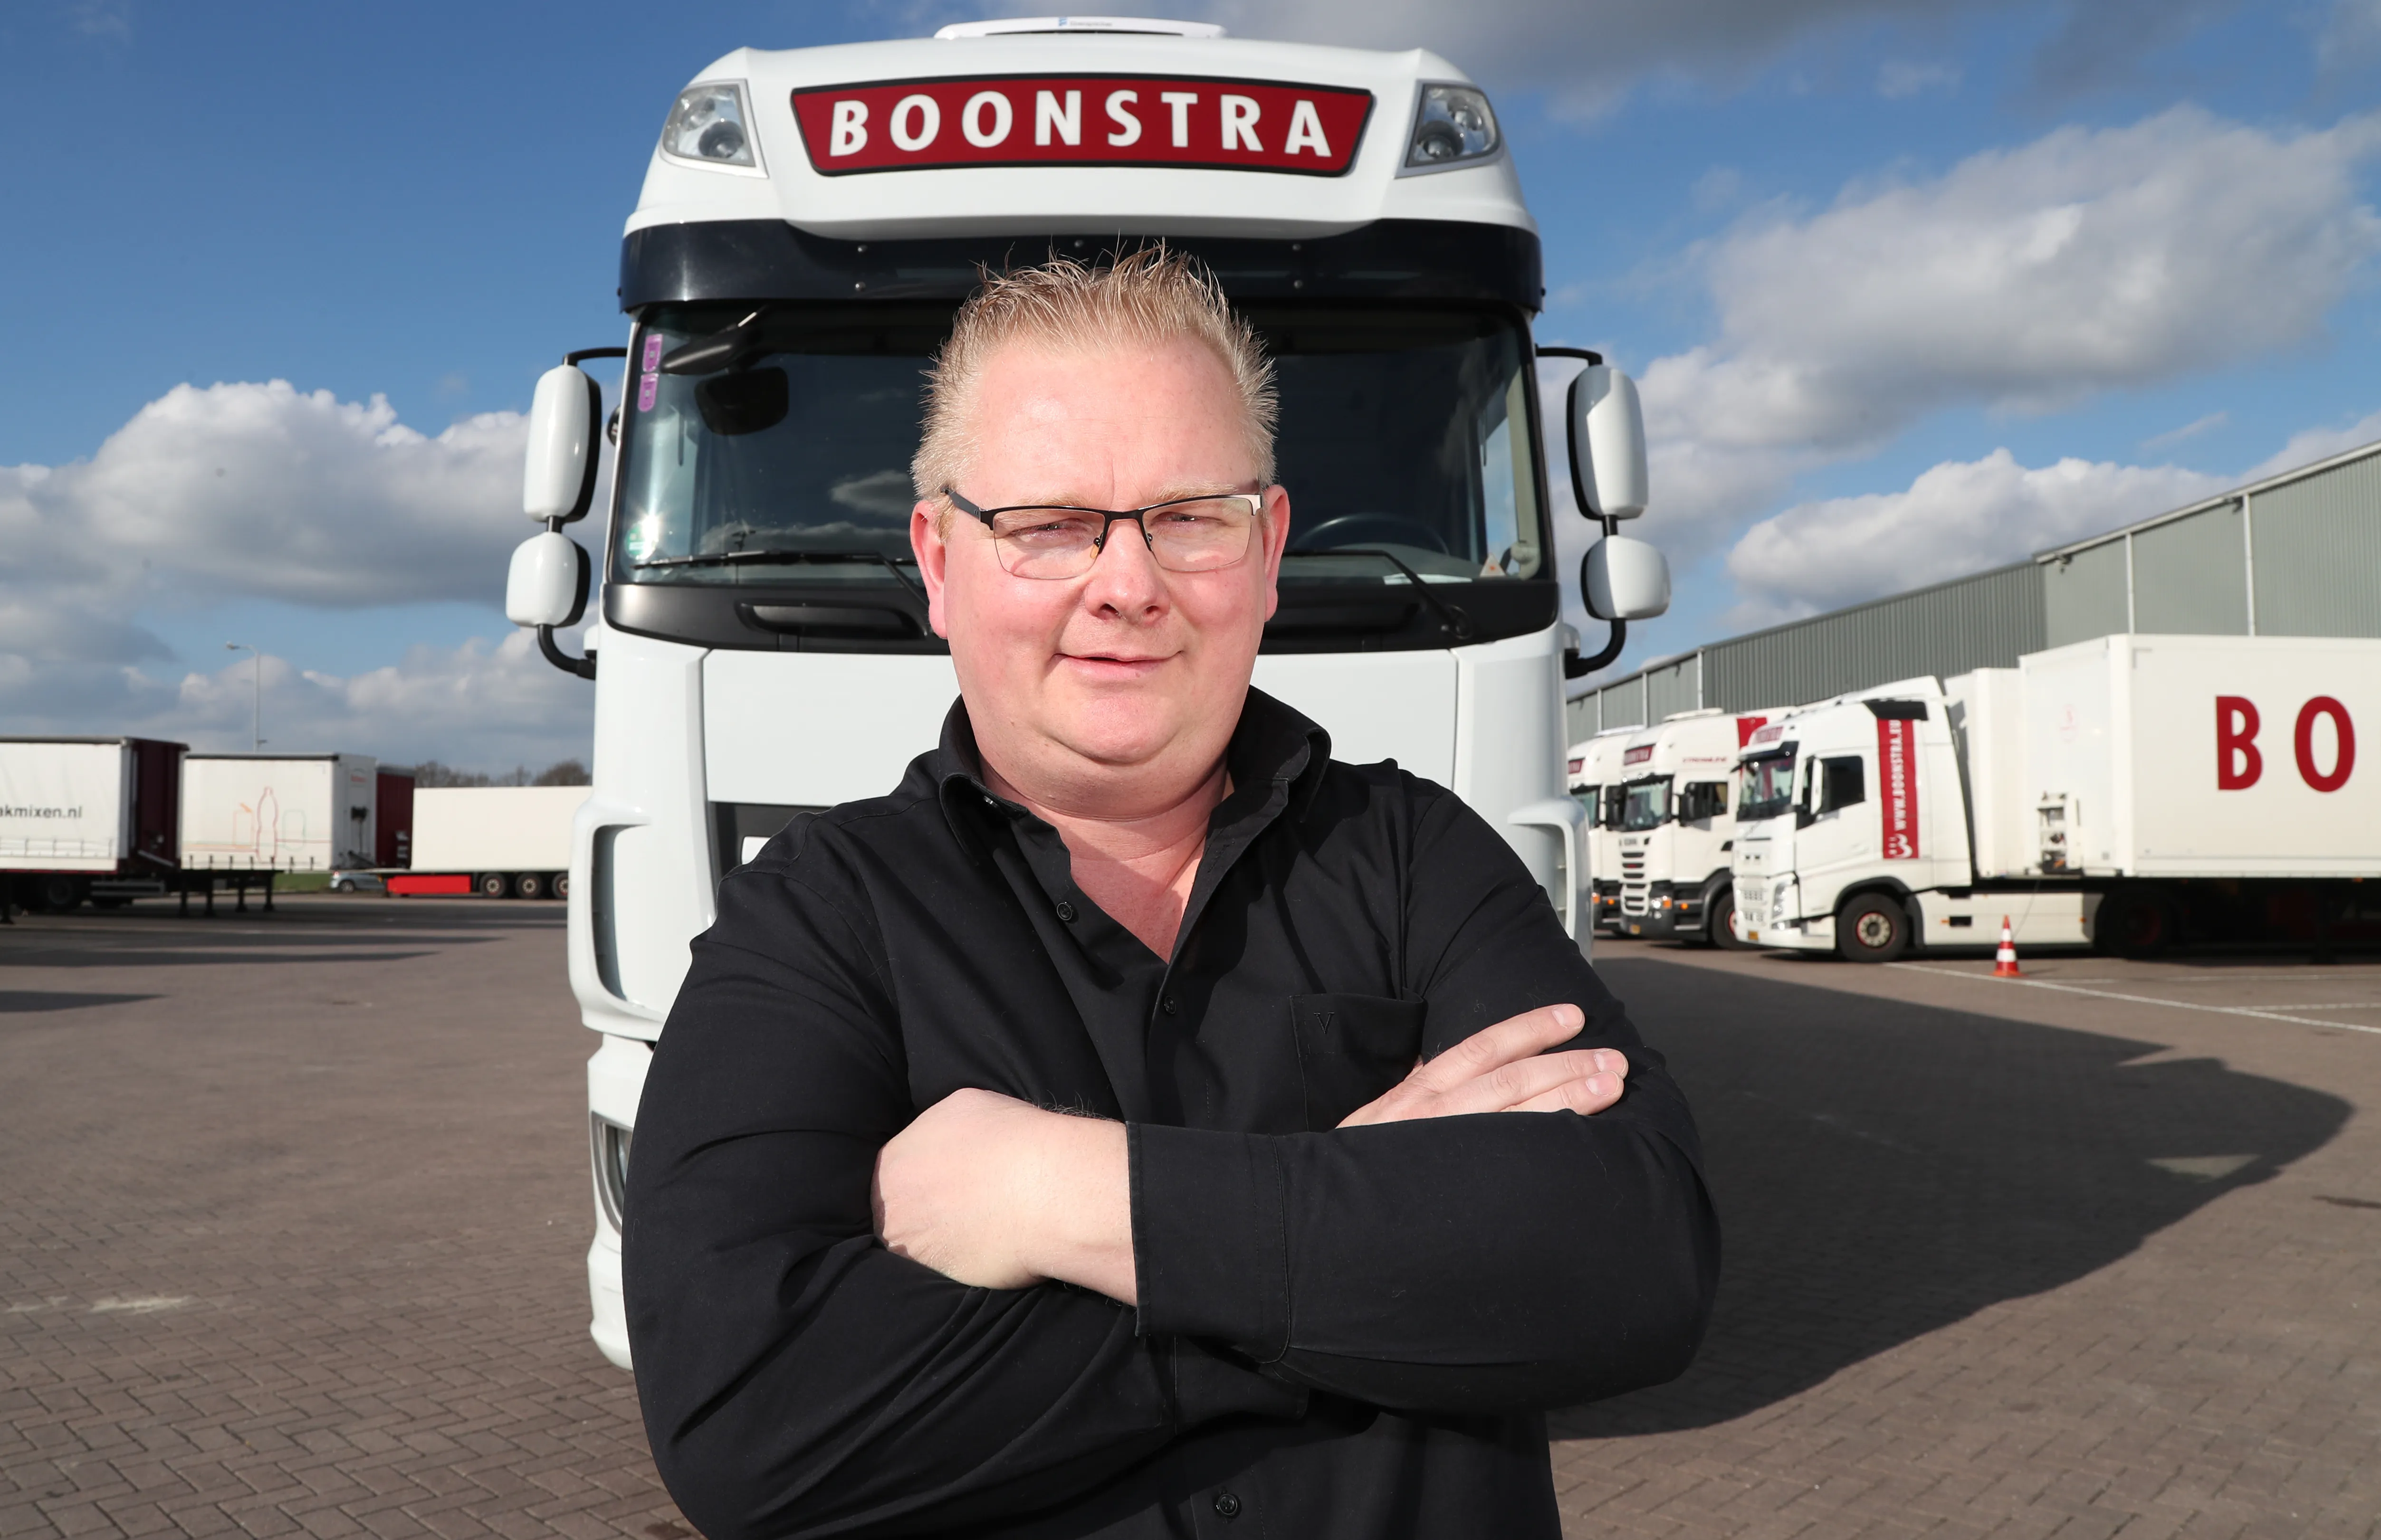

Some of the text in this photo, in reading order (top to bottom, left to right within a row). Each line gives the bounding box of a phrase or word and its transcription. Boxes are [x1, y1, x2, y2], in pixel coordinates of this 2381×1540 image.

[829, 89, 1332, 157] BOONSTRA
[1888, 719, 1906, 831] WWW.BOONSTRA.EU
[1313, 1012, 1335, 1035] V
